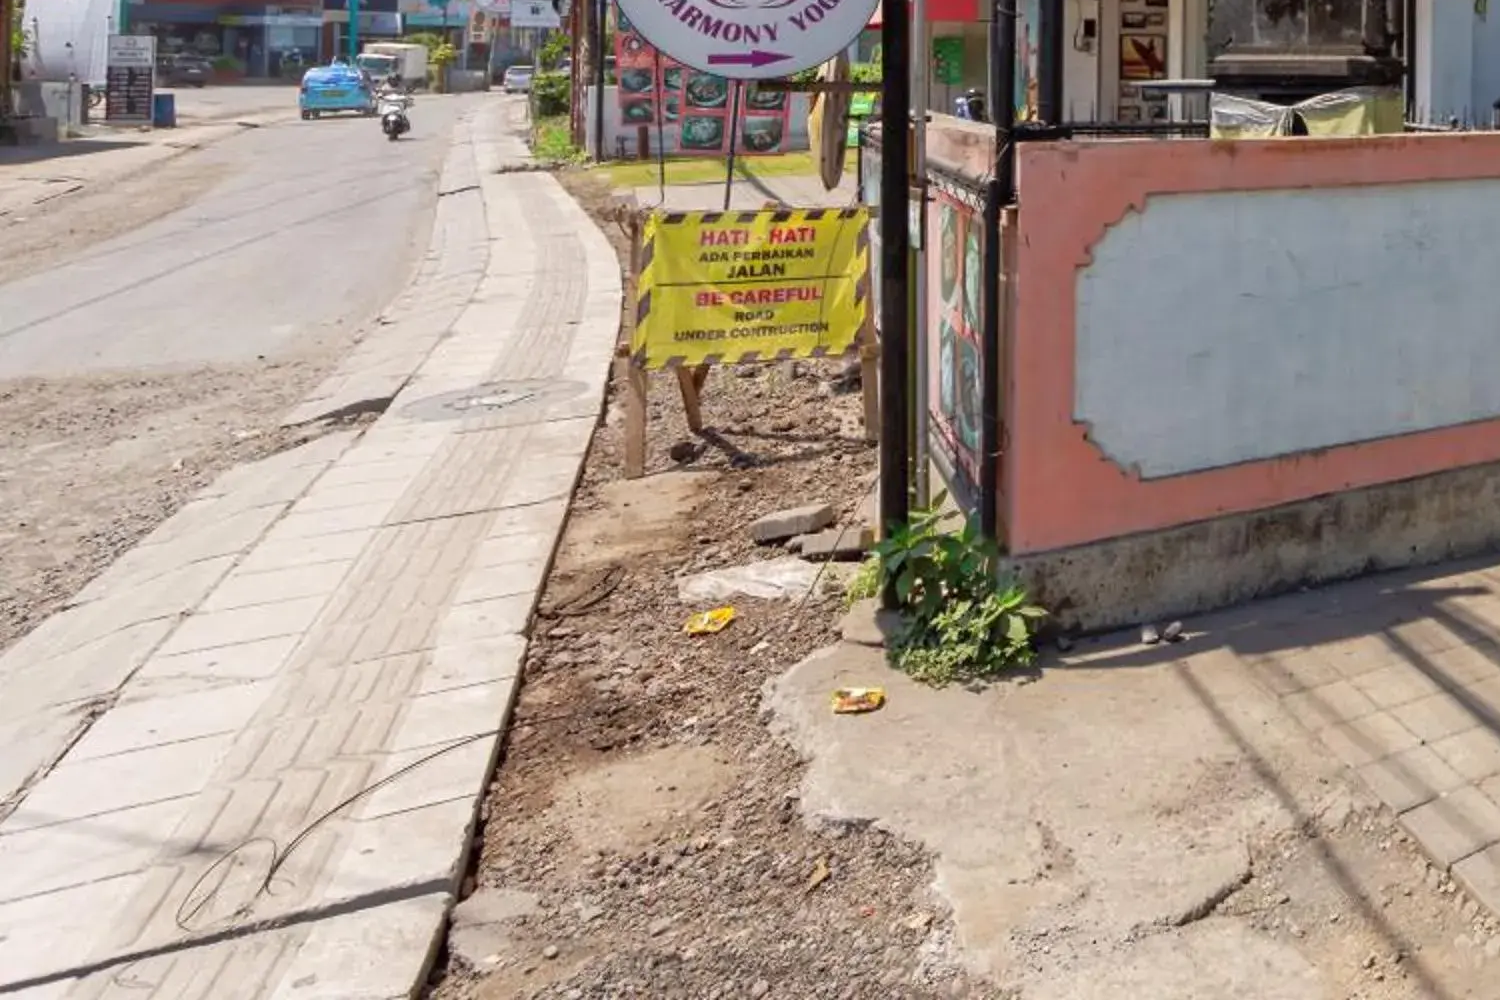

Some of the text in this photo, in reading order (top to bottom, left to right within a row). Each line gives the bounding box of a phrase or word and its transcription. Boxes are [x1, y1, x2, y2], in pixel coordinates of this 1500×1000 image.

[700, 229, 749, 246] HATI
[769, 227, 815, 244] HATI
[699, 248, 815, 262] ADA PERBAIKAN
[727, 263, 785, 278] JALAN
[695, 287, 824, 307] BE CAREFUL
[734, 310, 775, 322] ROAD
[674, 329, 726, 342] UNDER
